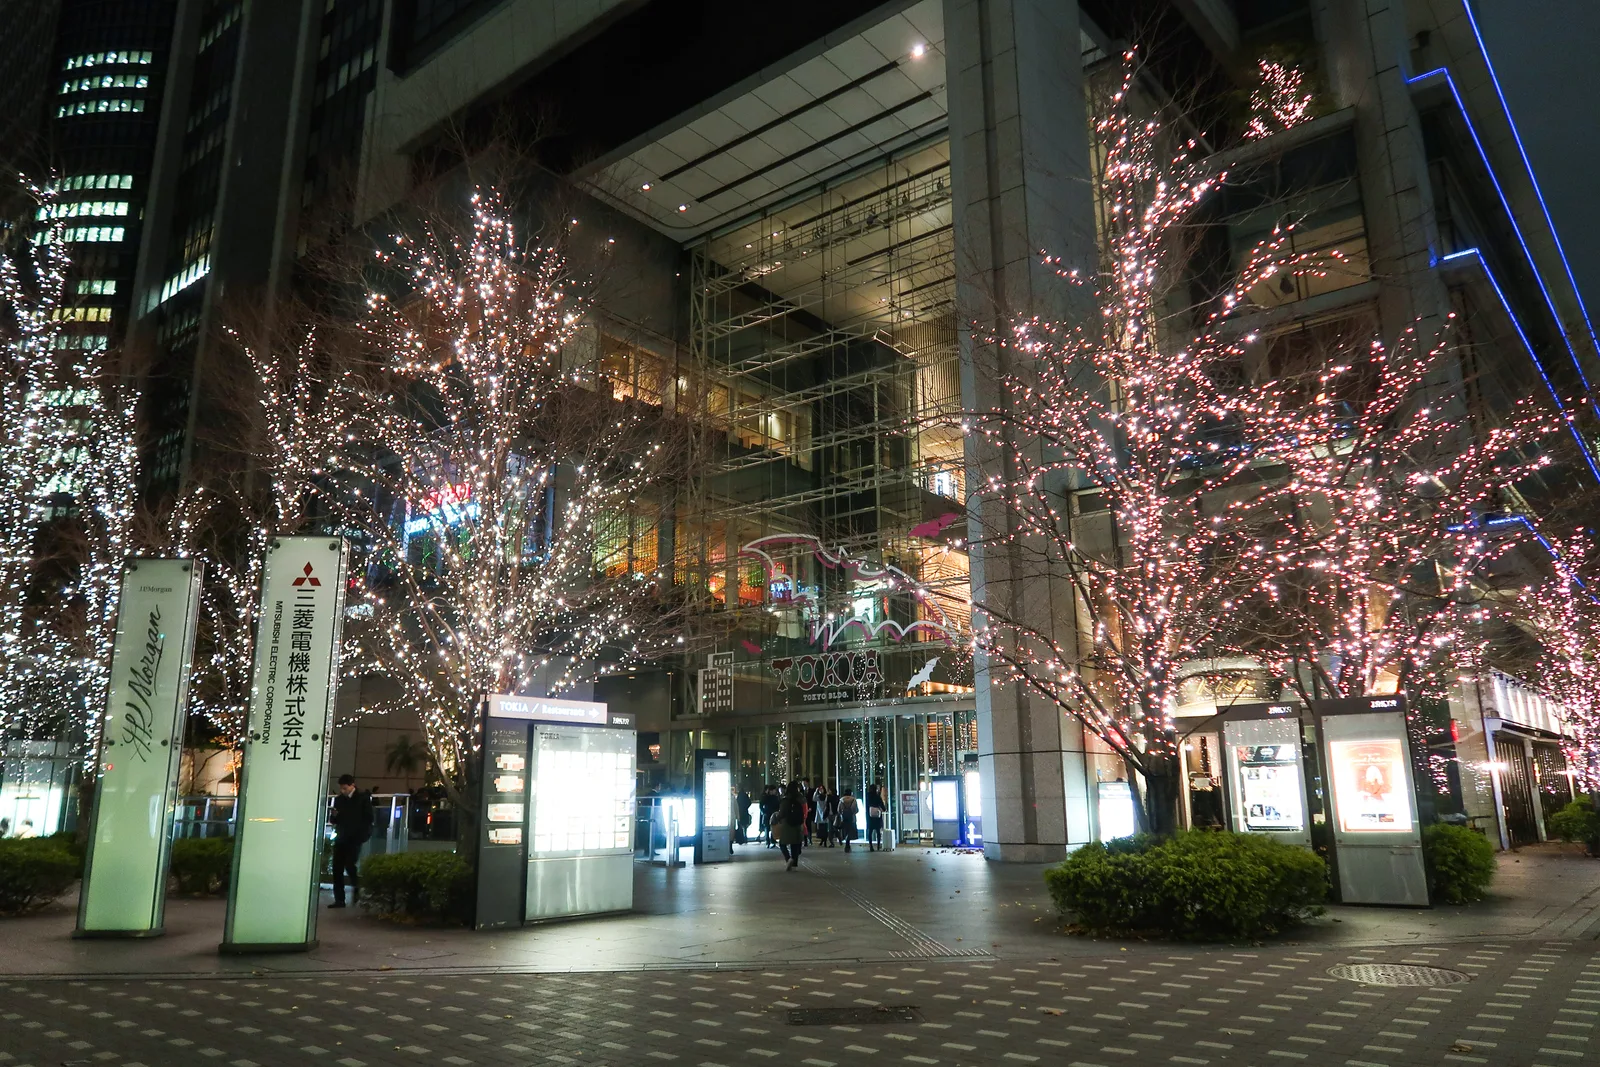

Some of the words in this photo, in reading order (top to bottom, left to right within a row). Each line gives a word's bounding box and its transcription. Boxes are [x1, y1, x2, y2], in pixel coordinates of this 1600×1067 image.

[272, 600, 283, 644] MITSUBISHI
[267, 646, 279, 684] ELECTRIC
[279, 589, 316, 761] 三菱電機株式会社
[771, 648, 885, 692] TOKIA
[261, 686, 275, 745] CORPORATION
[499, 700, 529, 713] TOKIA
[541, 704, 585, 717] Restaurants
[803, 693, 827, 702] TOKYO
[828, 691, 849, 699] BLDG.
